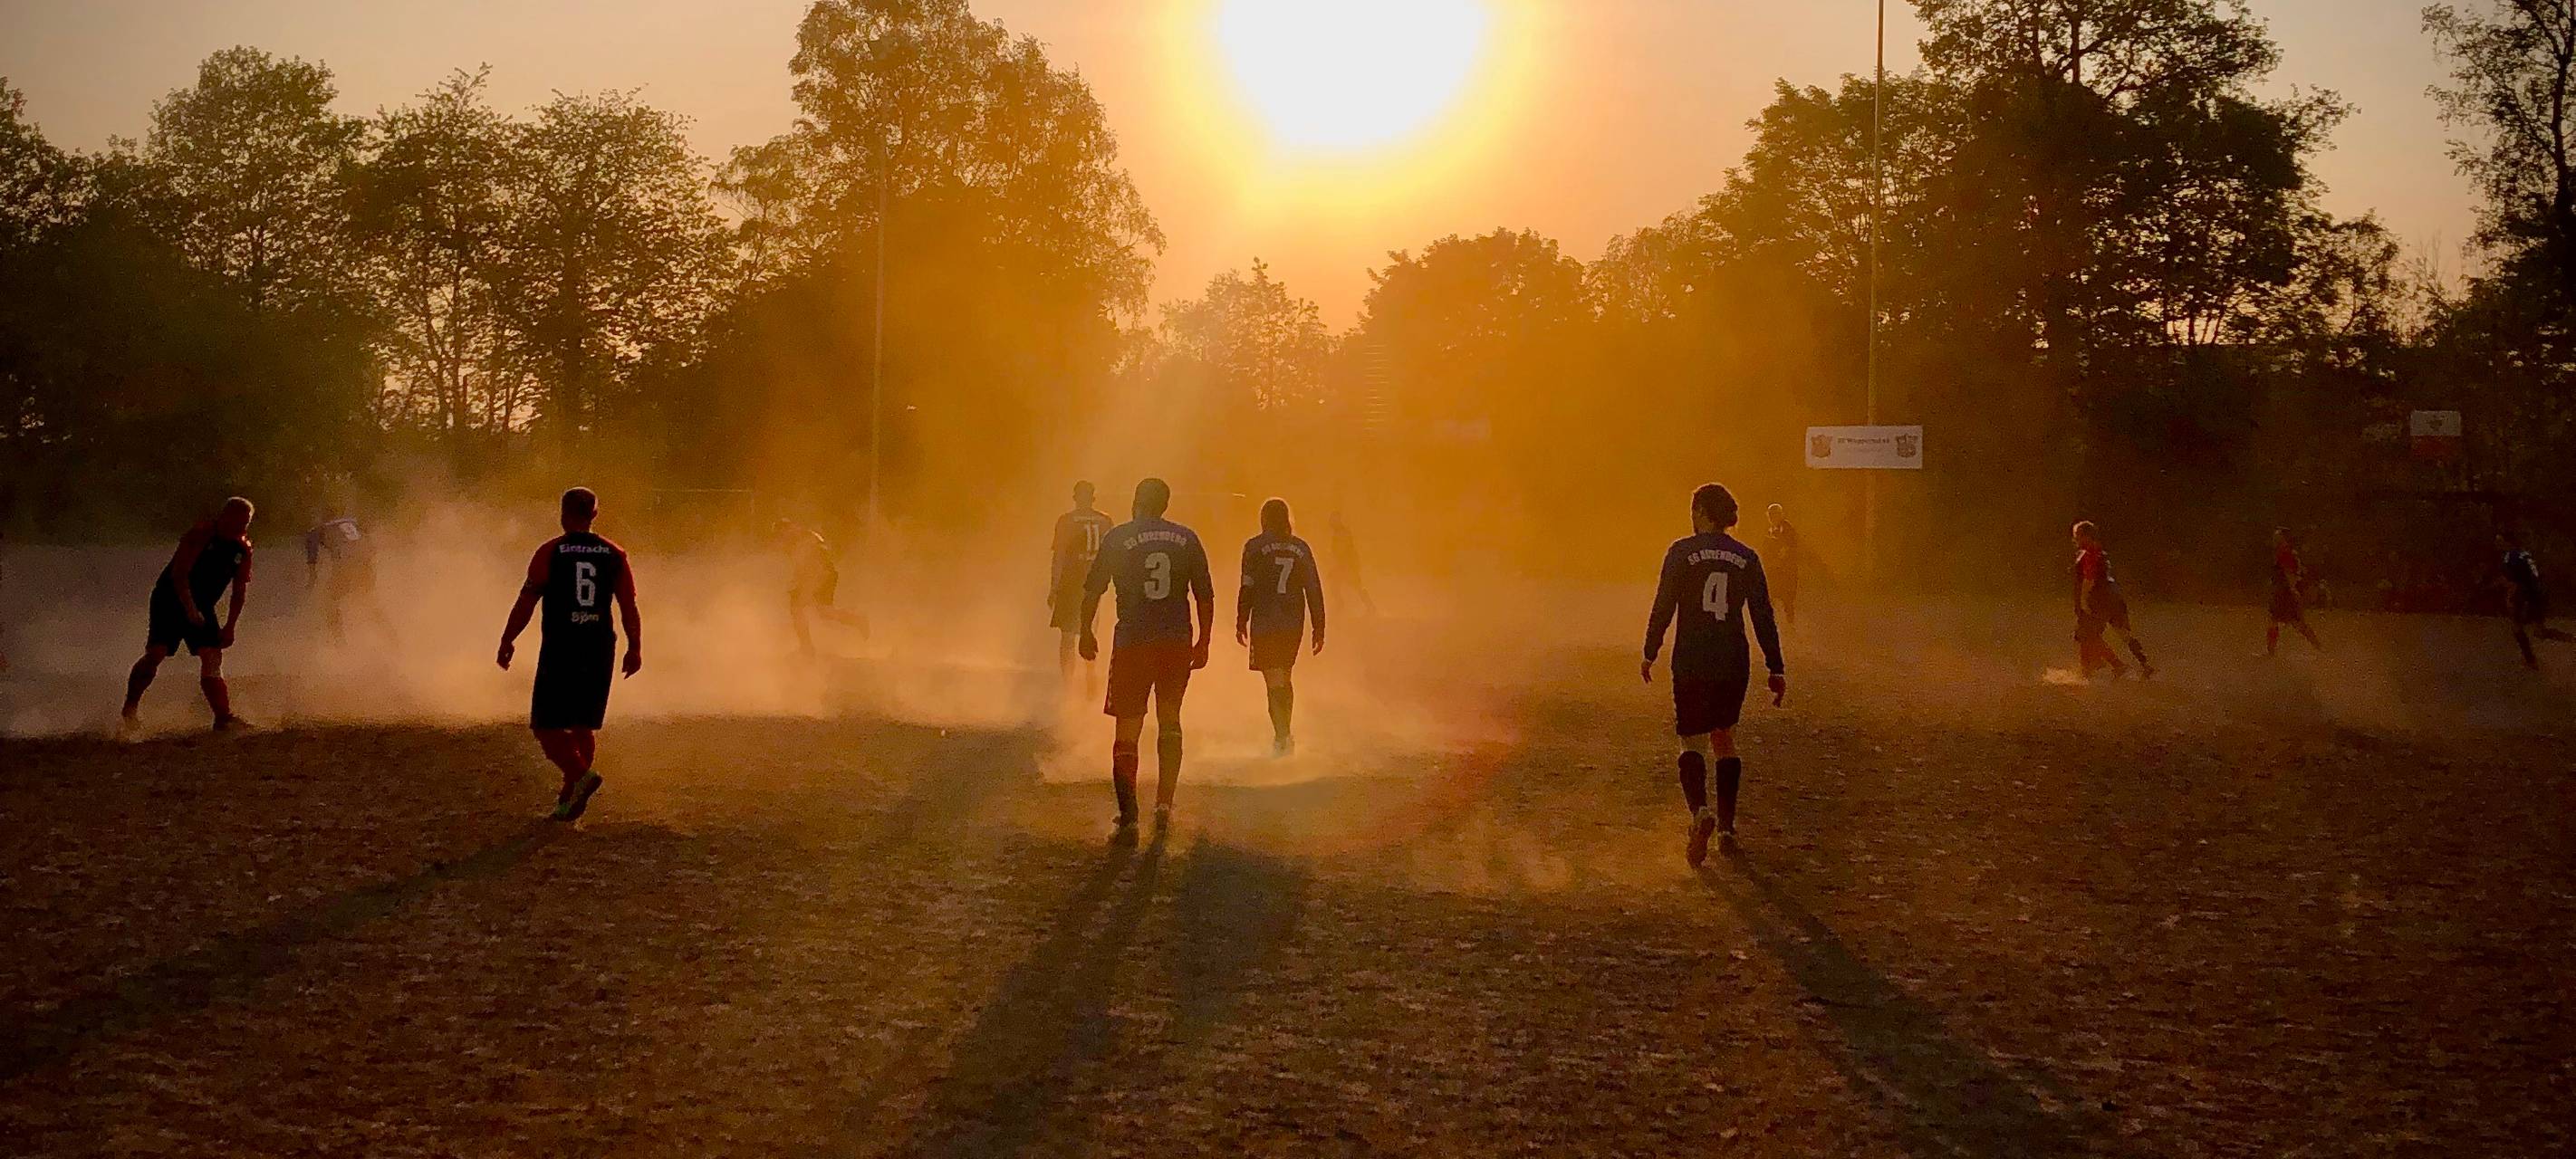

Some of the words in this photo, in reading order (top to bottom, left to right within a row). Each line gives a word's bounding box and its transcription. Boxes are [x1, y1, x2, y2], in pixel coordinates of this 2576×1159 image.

[576, 561, 596, 607] 6
[1144, 551, 1171, 599] 3
[1274, 556, 1294, 594] 7
[1703, 571, 1729, 621] 4
